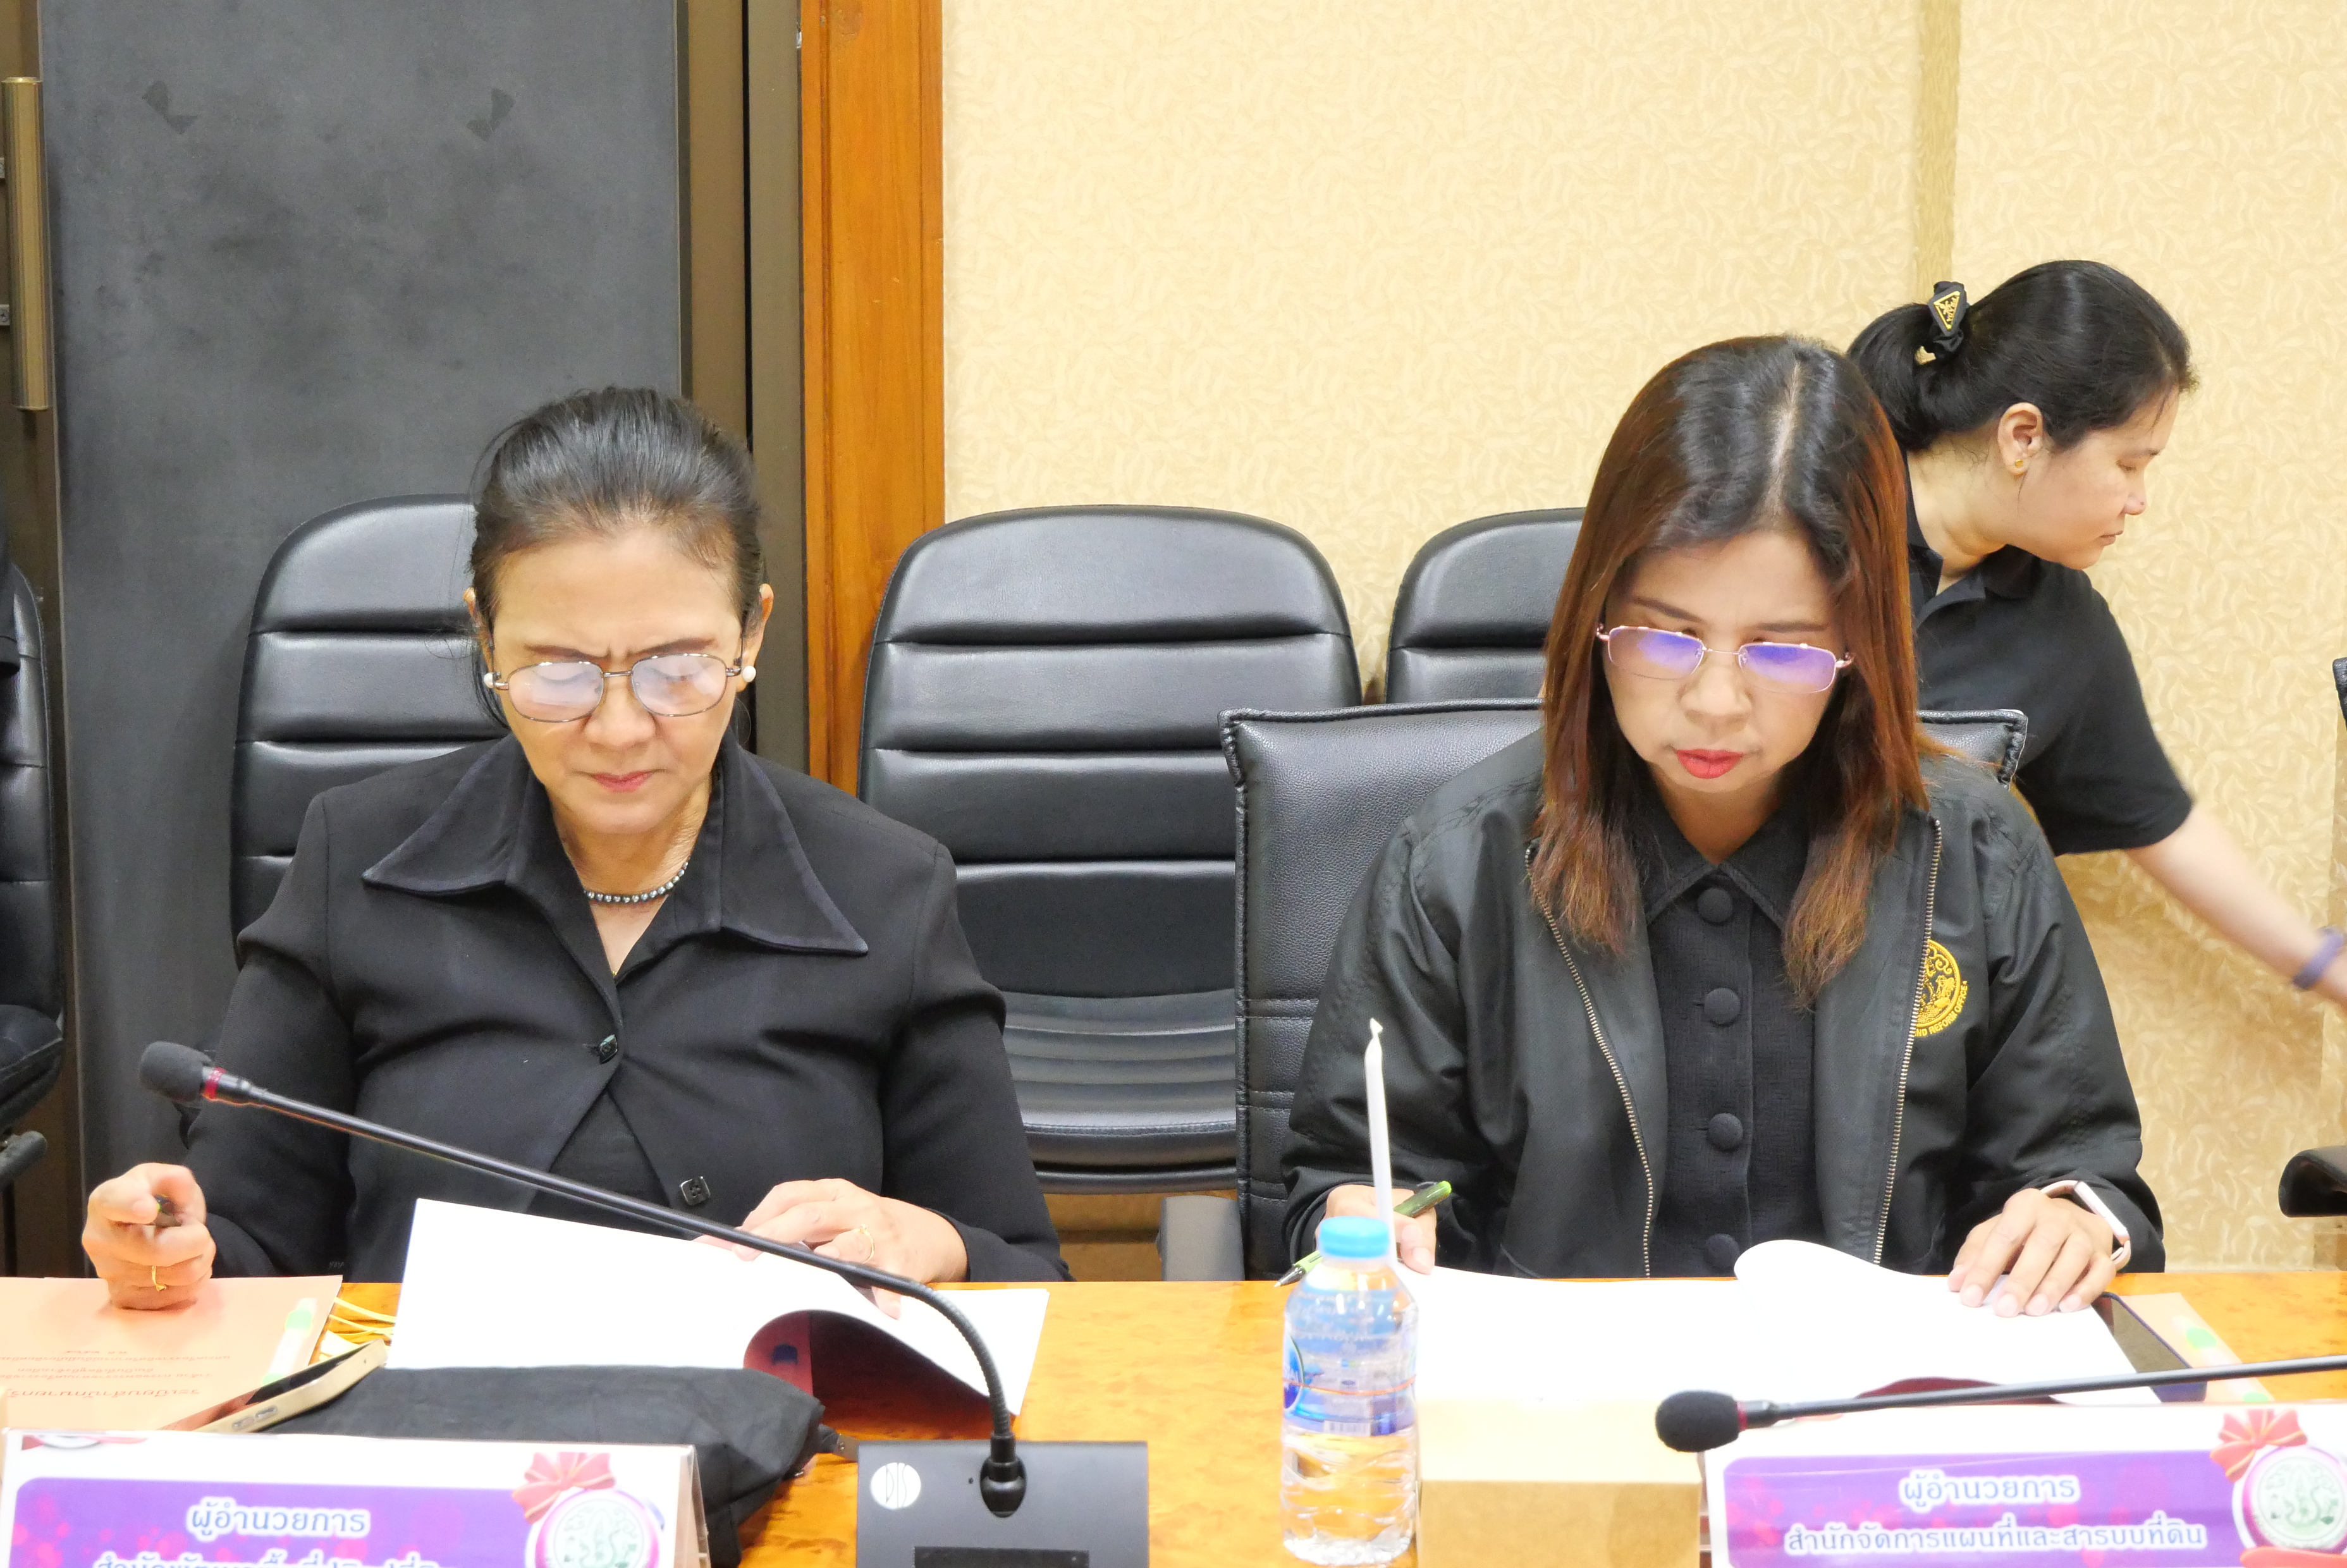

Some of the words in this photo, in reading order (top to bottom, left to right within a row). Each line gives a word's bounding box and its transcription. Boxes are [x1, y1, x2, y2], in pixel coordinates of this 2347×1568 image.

[1928, 1011, 1958, 1034] REFORM
[1954, 985, 1968, 1012] OFFICE
[8, 1388, 200, 1399] ระเบียบสำนักนายกรั
[1904, 1473, 2076, 1507] ผู้อำนวยการ
[192, 1501, 366, 1536] ผู้อำนวยการ
[1788, 1514, 2203, 1550] สำนักจัดการแผนที่และสารบบที่ดิน
